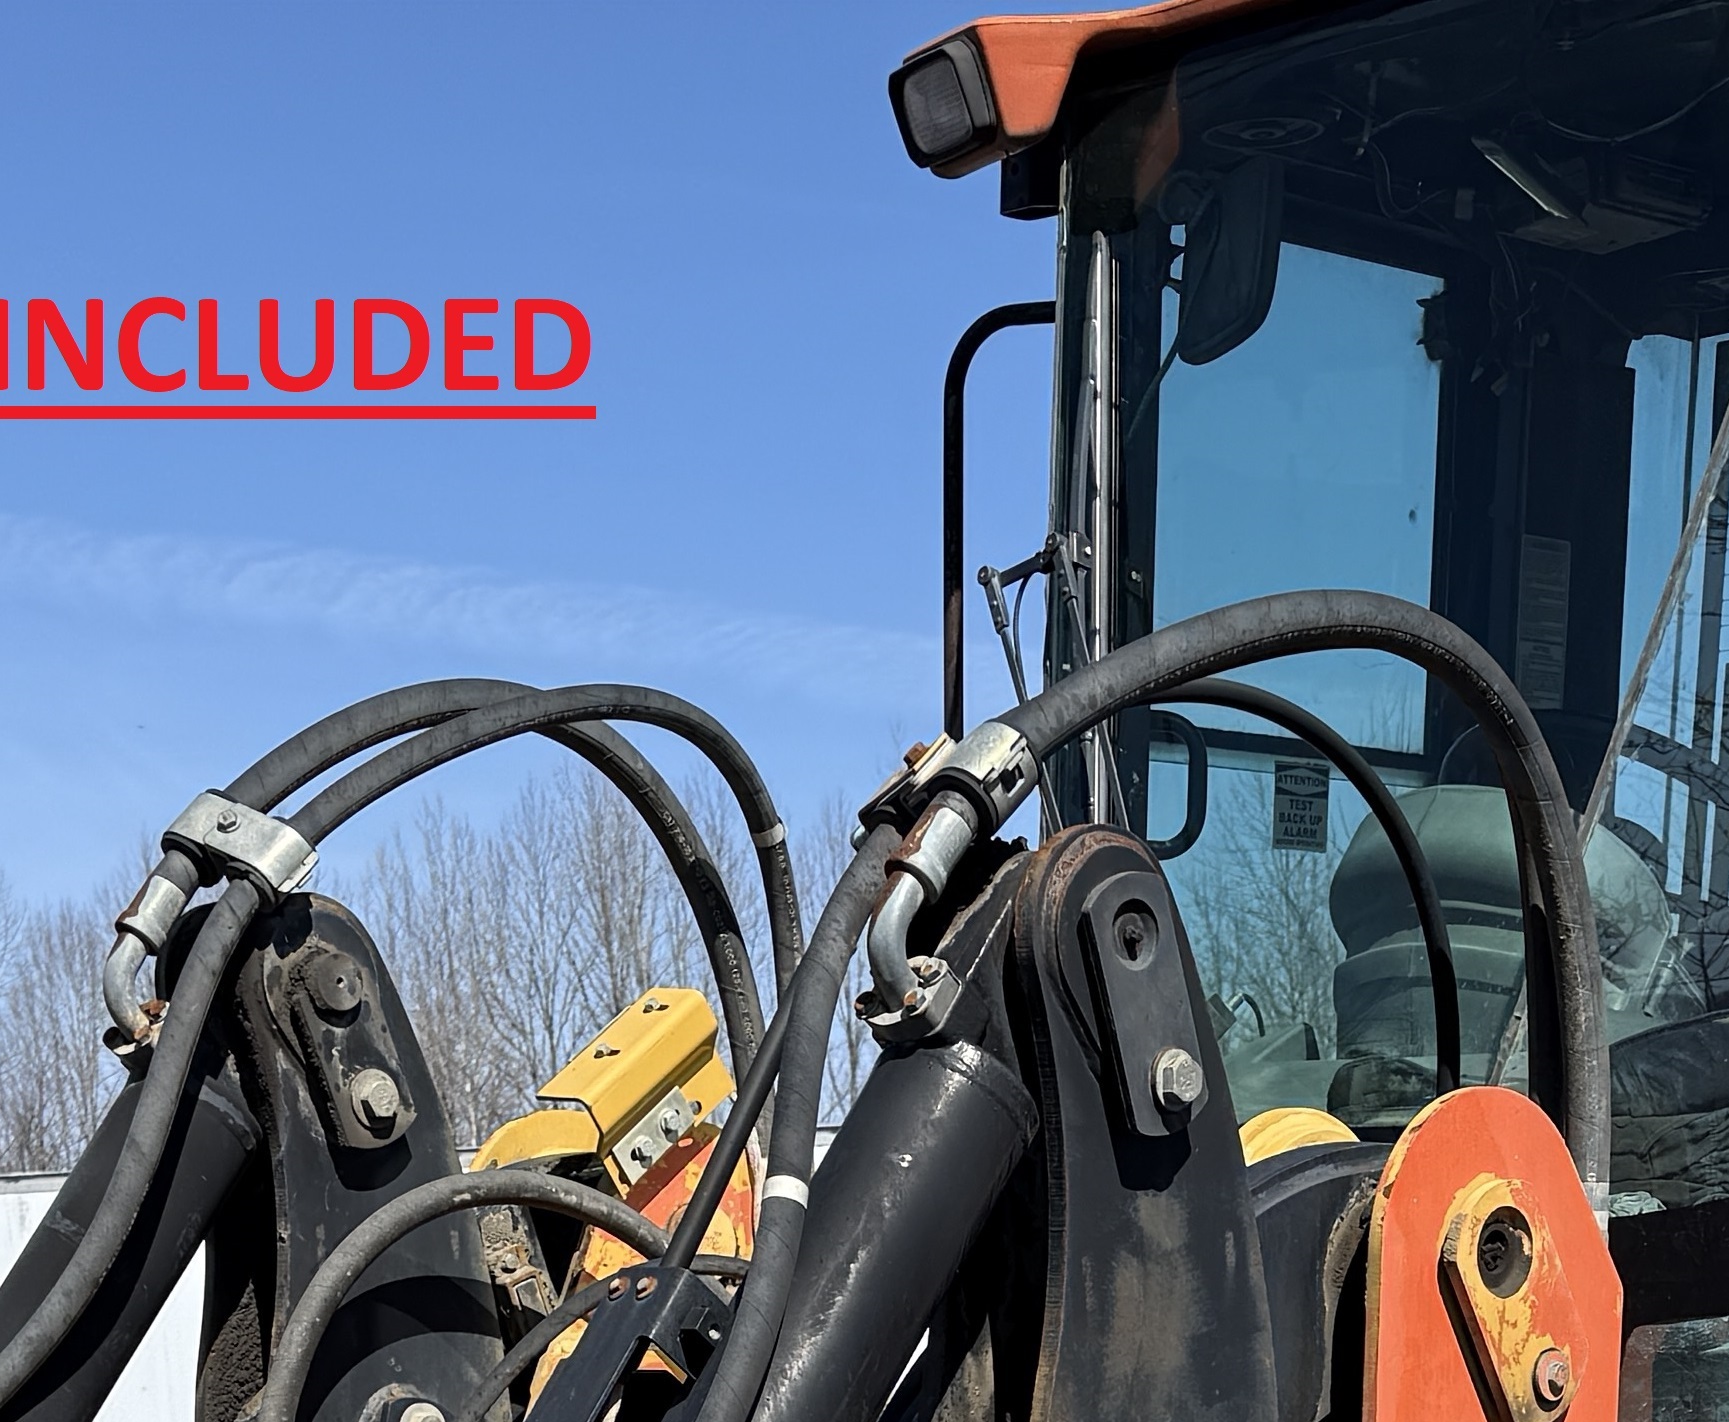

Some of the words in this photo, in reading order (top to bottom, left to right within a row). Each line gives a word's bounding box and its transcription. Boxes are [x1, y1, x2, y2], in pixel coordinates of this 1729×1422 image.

[1278, 774, 1327, 787] ATTENTION
[1289, 799, 1313, 812] TEST
[1282, 826, 1317, 839] ALARM
